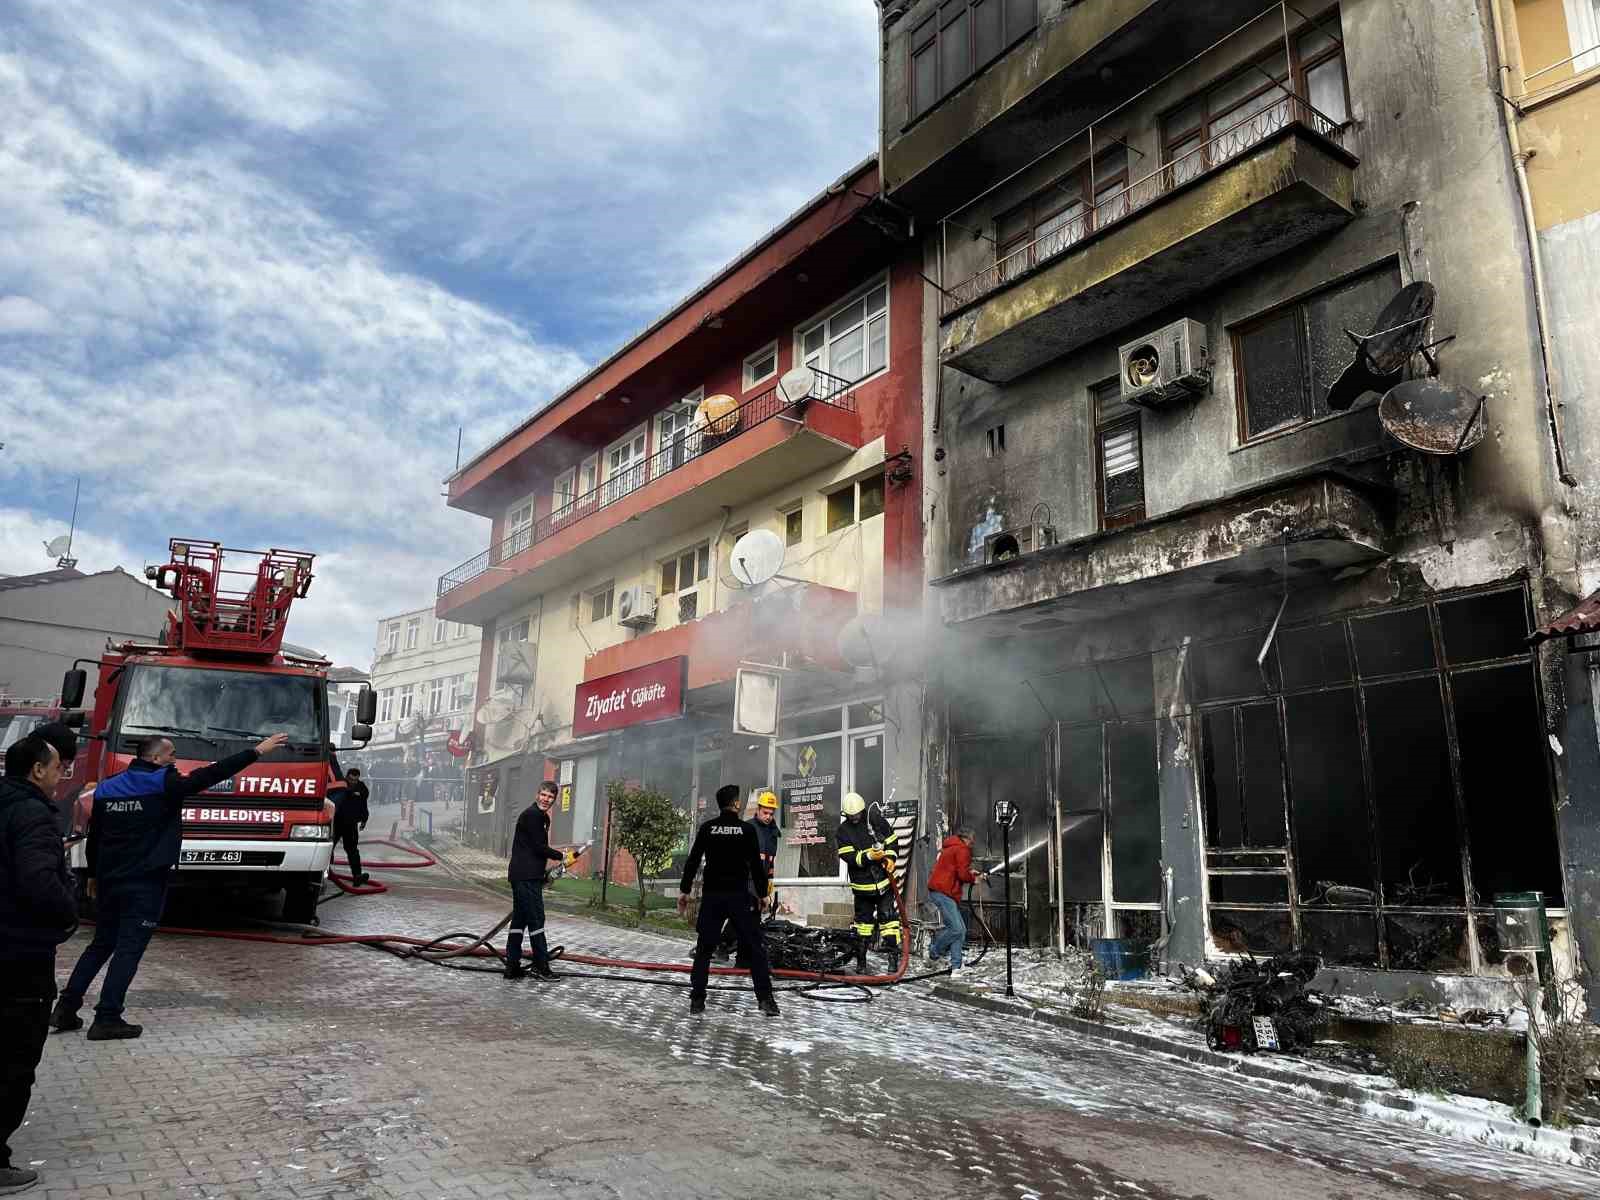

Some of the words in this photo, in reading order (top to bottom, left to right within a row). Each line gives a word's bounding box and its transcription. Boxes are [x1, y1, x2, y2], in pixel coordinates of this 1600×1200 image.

[584, 689, 626, 721] Ziyafet
[710, 825, 744, 835] ZABITA
[186, 852, 198, 861] 57
[203, 852, 216, 861] FC
[221, 852, 240, 861] 463
